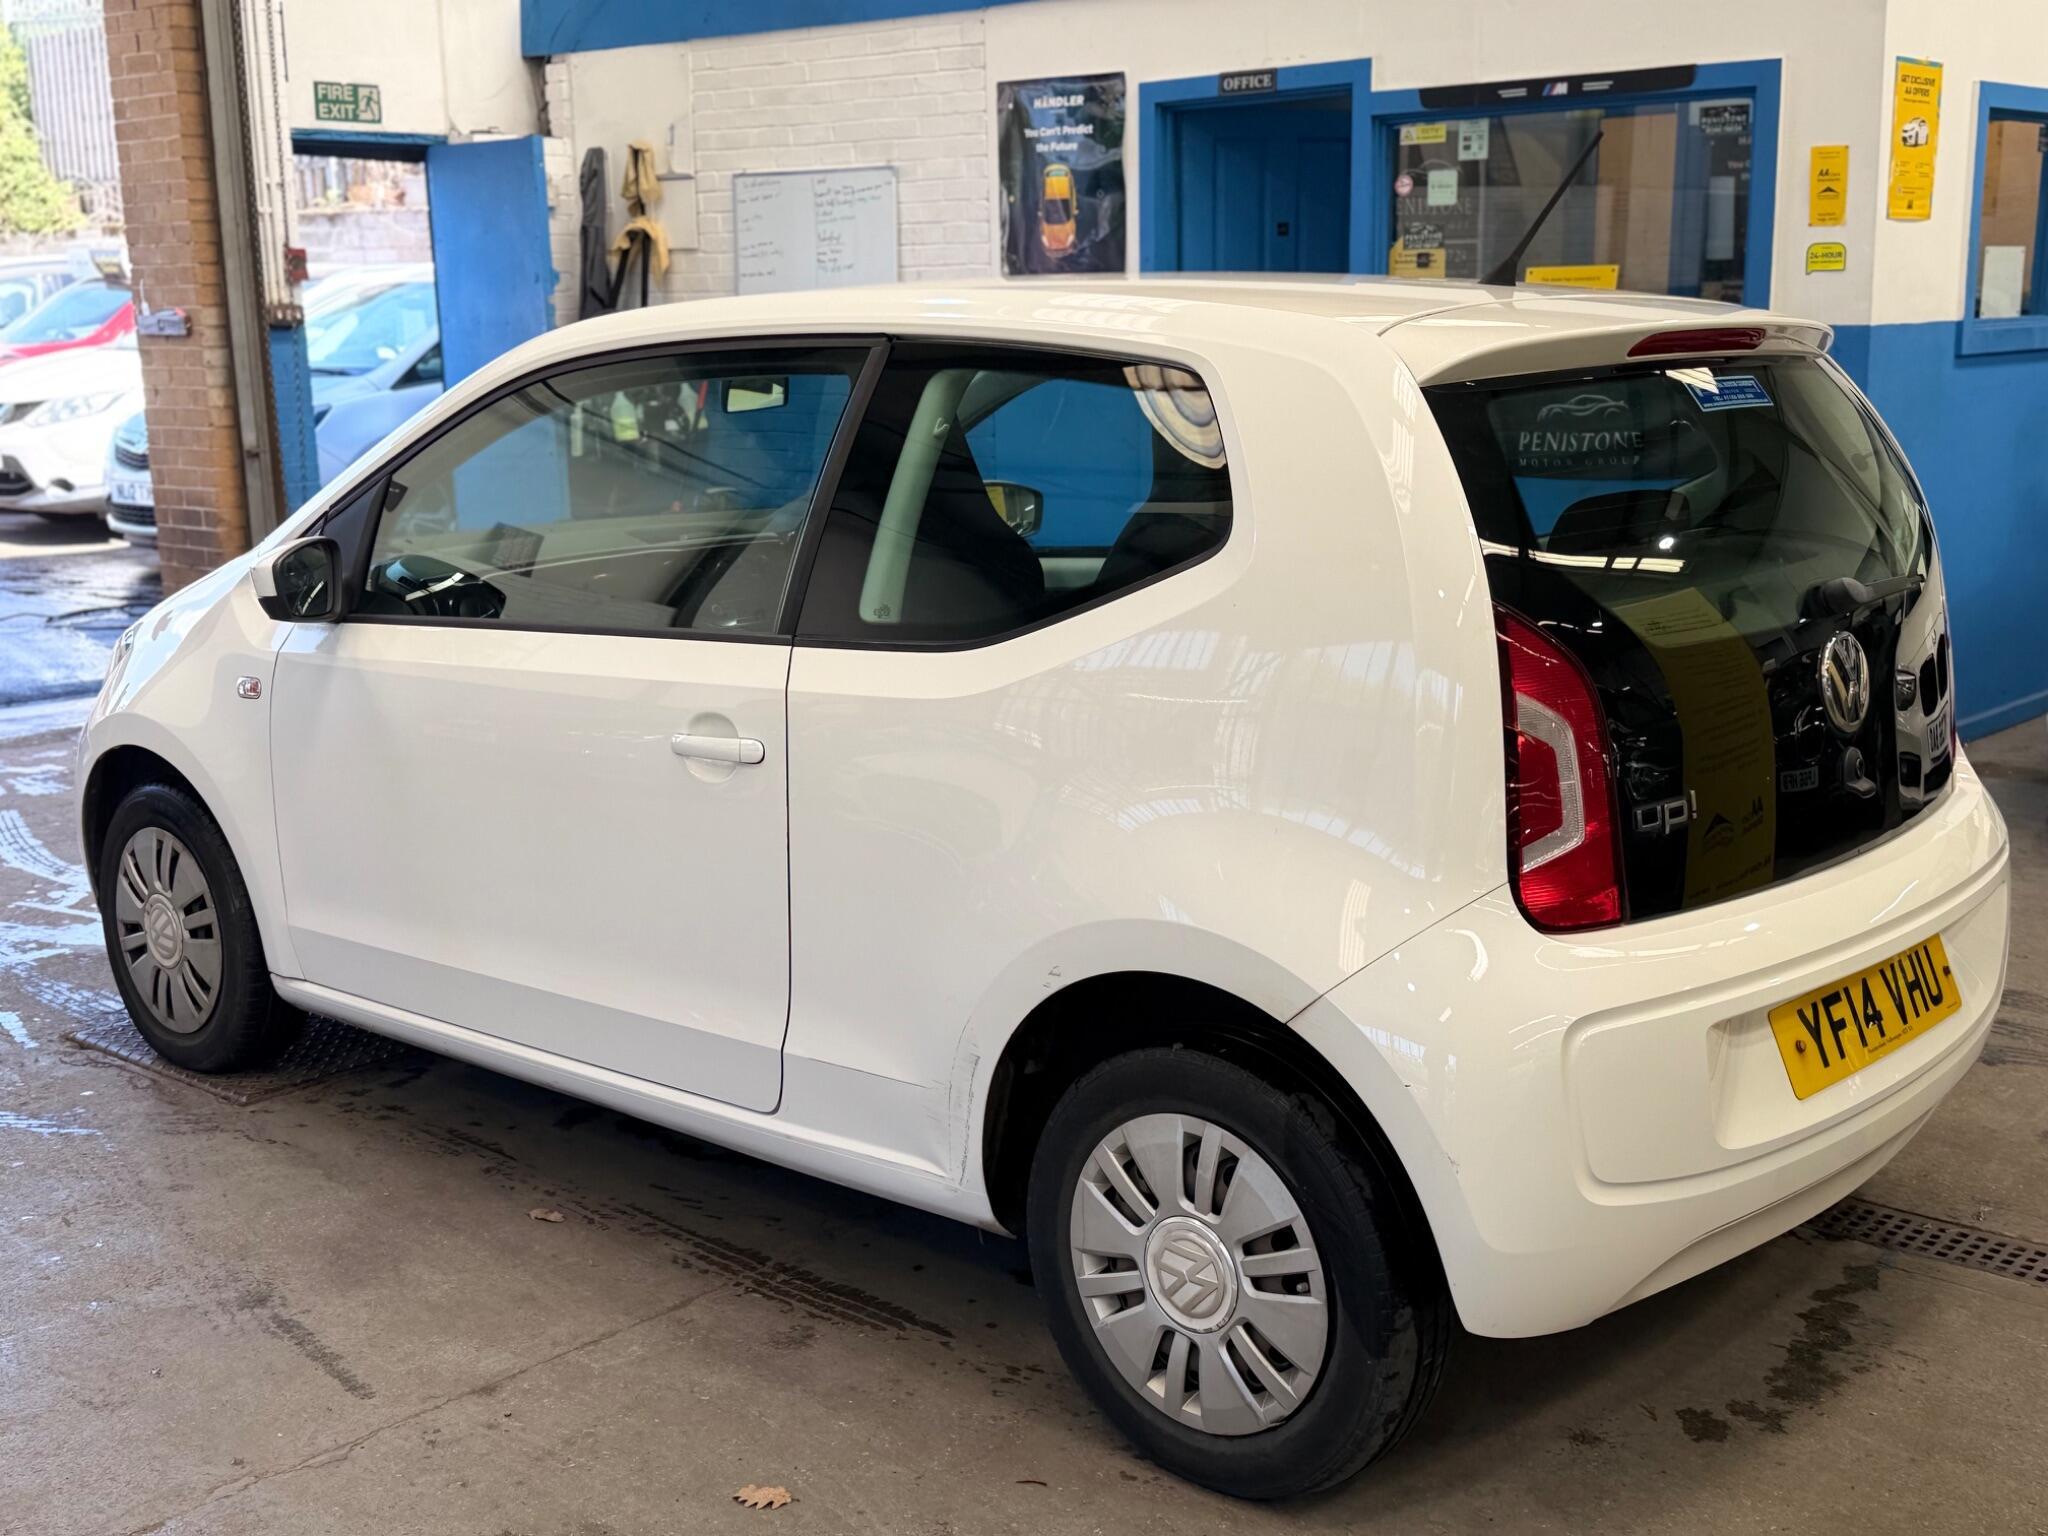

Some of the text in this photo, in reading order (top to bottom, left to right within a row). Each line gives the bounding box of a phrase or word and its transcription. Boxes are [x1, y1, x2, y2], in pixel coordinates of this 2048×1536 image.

[1223, 74, 1272, 91] OFFICE
[318, 84, 354, 101] FIRE
[319, 102, 355, 119] EXIT
[1062, 123, 1093, 135] Predict
[1050, 142, 1078, 152] Future
[1519, 431, 1645, 452] PENISTONE
[1797, 944, 1944, 1069] YF14 VHU
